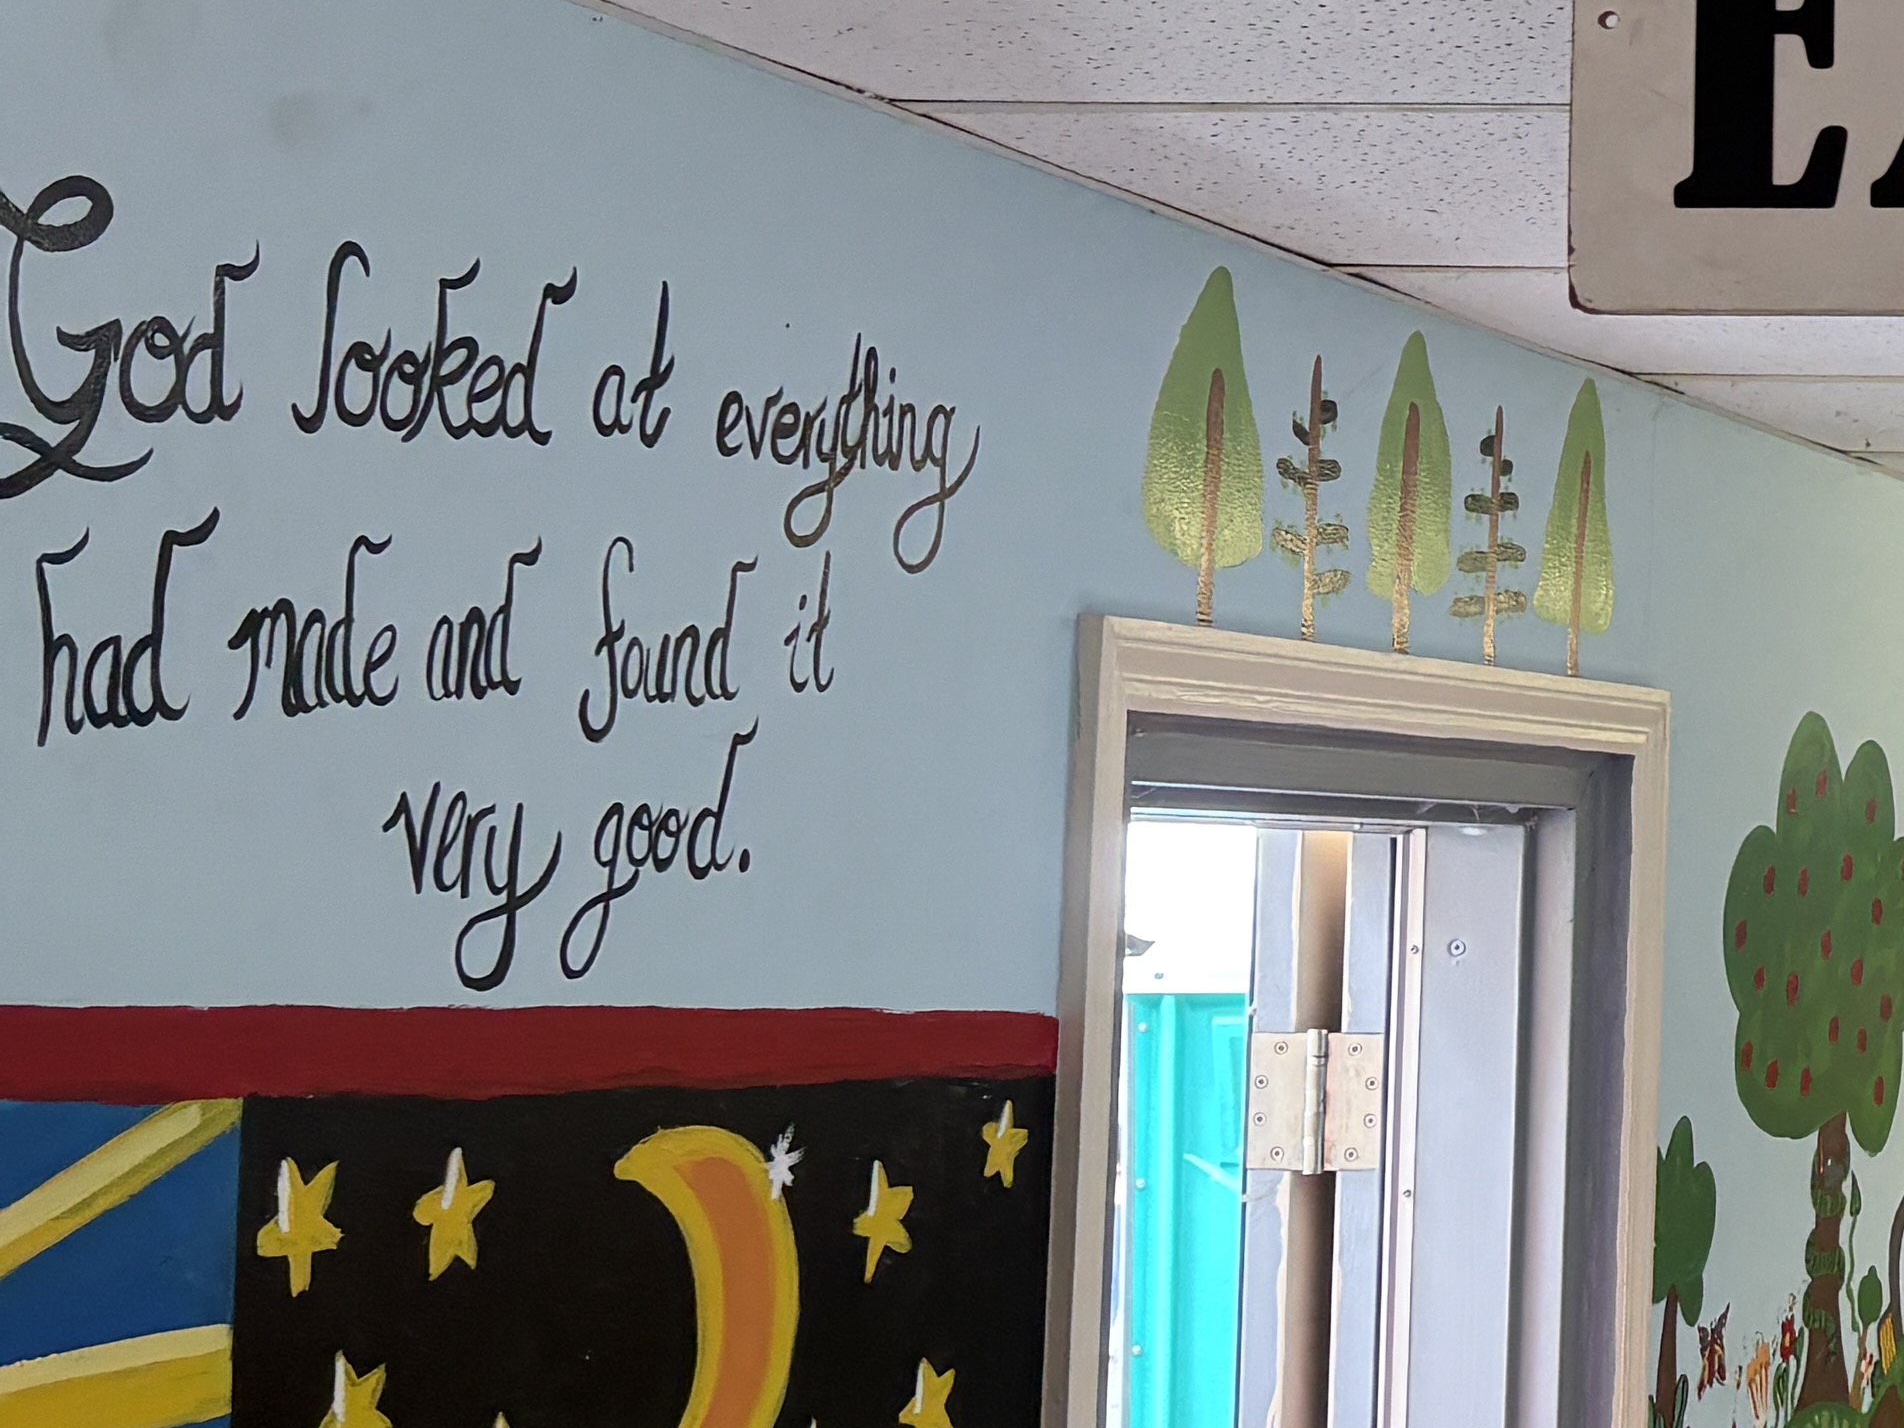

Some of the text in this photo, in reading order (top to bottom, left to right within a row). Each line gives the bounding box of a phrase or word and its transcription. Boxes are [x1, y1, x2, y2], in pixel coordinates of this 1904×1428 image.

[0, 175, 981, 574] God looked at everything
[36, 507, 835, 747] had made and found it
[382, 717, 759, 991] very good.
